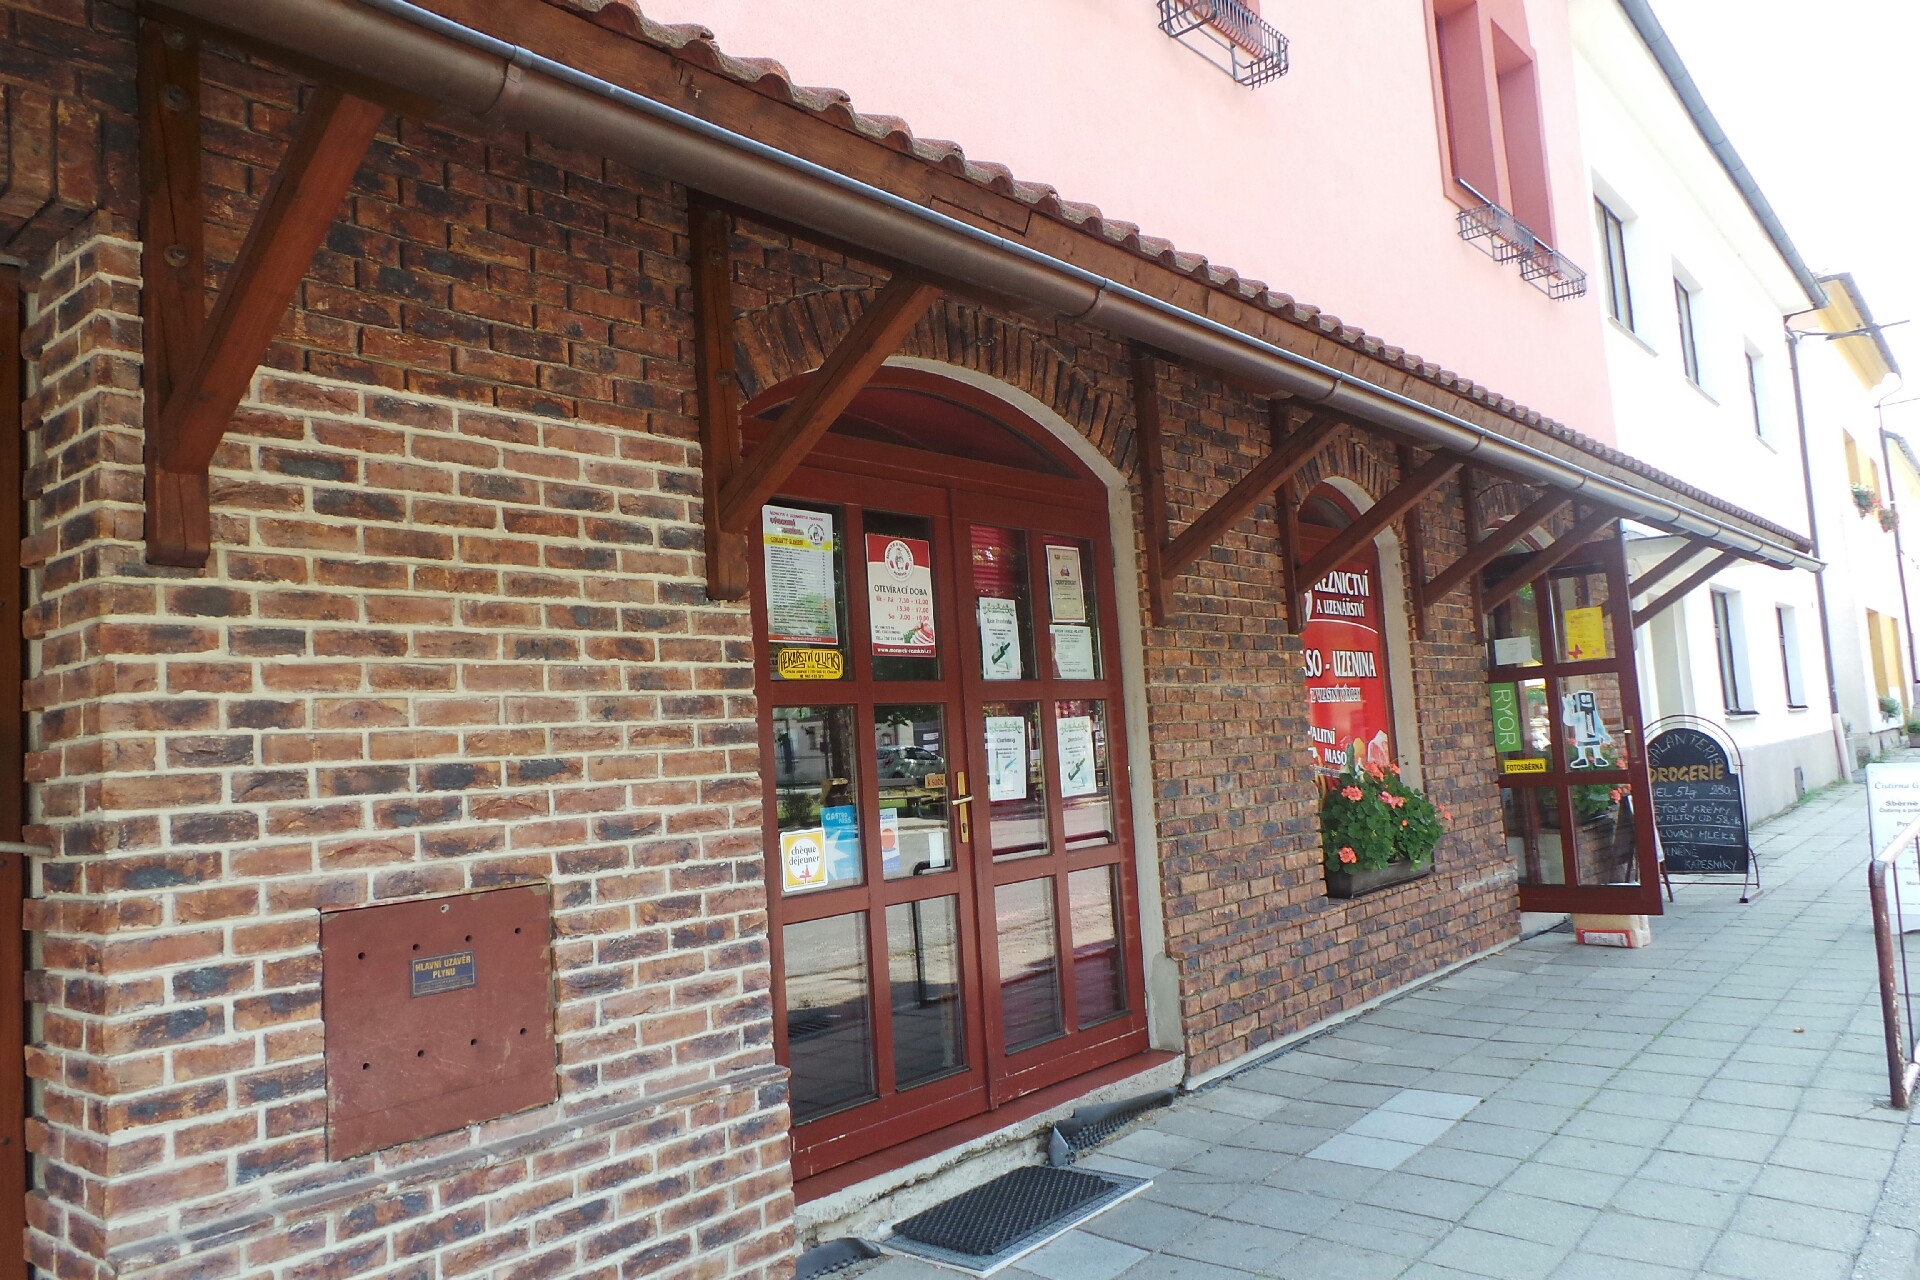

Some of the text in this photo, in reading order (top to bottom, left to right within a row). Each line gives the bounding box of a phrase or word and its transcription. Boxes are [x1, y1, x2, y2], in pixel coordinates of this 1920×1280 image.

[874, 584, 928, 596] OTEVÍRACÍ DOBA
[1316, 598, 1365, 617] A UZENÁŘSTVÍ
[1332, 650, 1377, 677] UZENINA
[1310, 688, 1316, 703] Z
[1316, 683, 1340, 703] VLASTNÍ
[1494, 690, 1516, 745] RYOR
[1324, 748, 1347, 765] MASO
[1506, 762, 1544, 772] FOTOSBĚRNA
[1648, 764, 1724, 784] DROGERIE
[1692, 802, 1730, 815] KRÉMY
[1666, 814, 1695, 822] FILTRY
[1660, 828, 1736, 842] LOVACÍ MLÉKA
[791, 845, 817, 856] chèque
[789, 856, 819, 866] déjeuner
[1685, 856, 1737, 871] KAPESNÍKY
[432, 968, 456, 979] PLYNU
